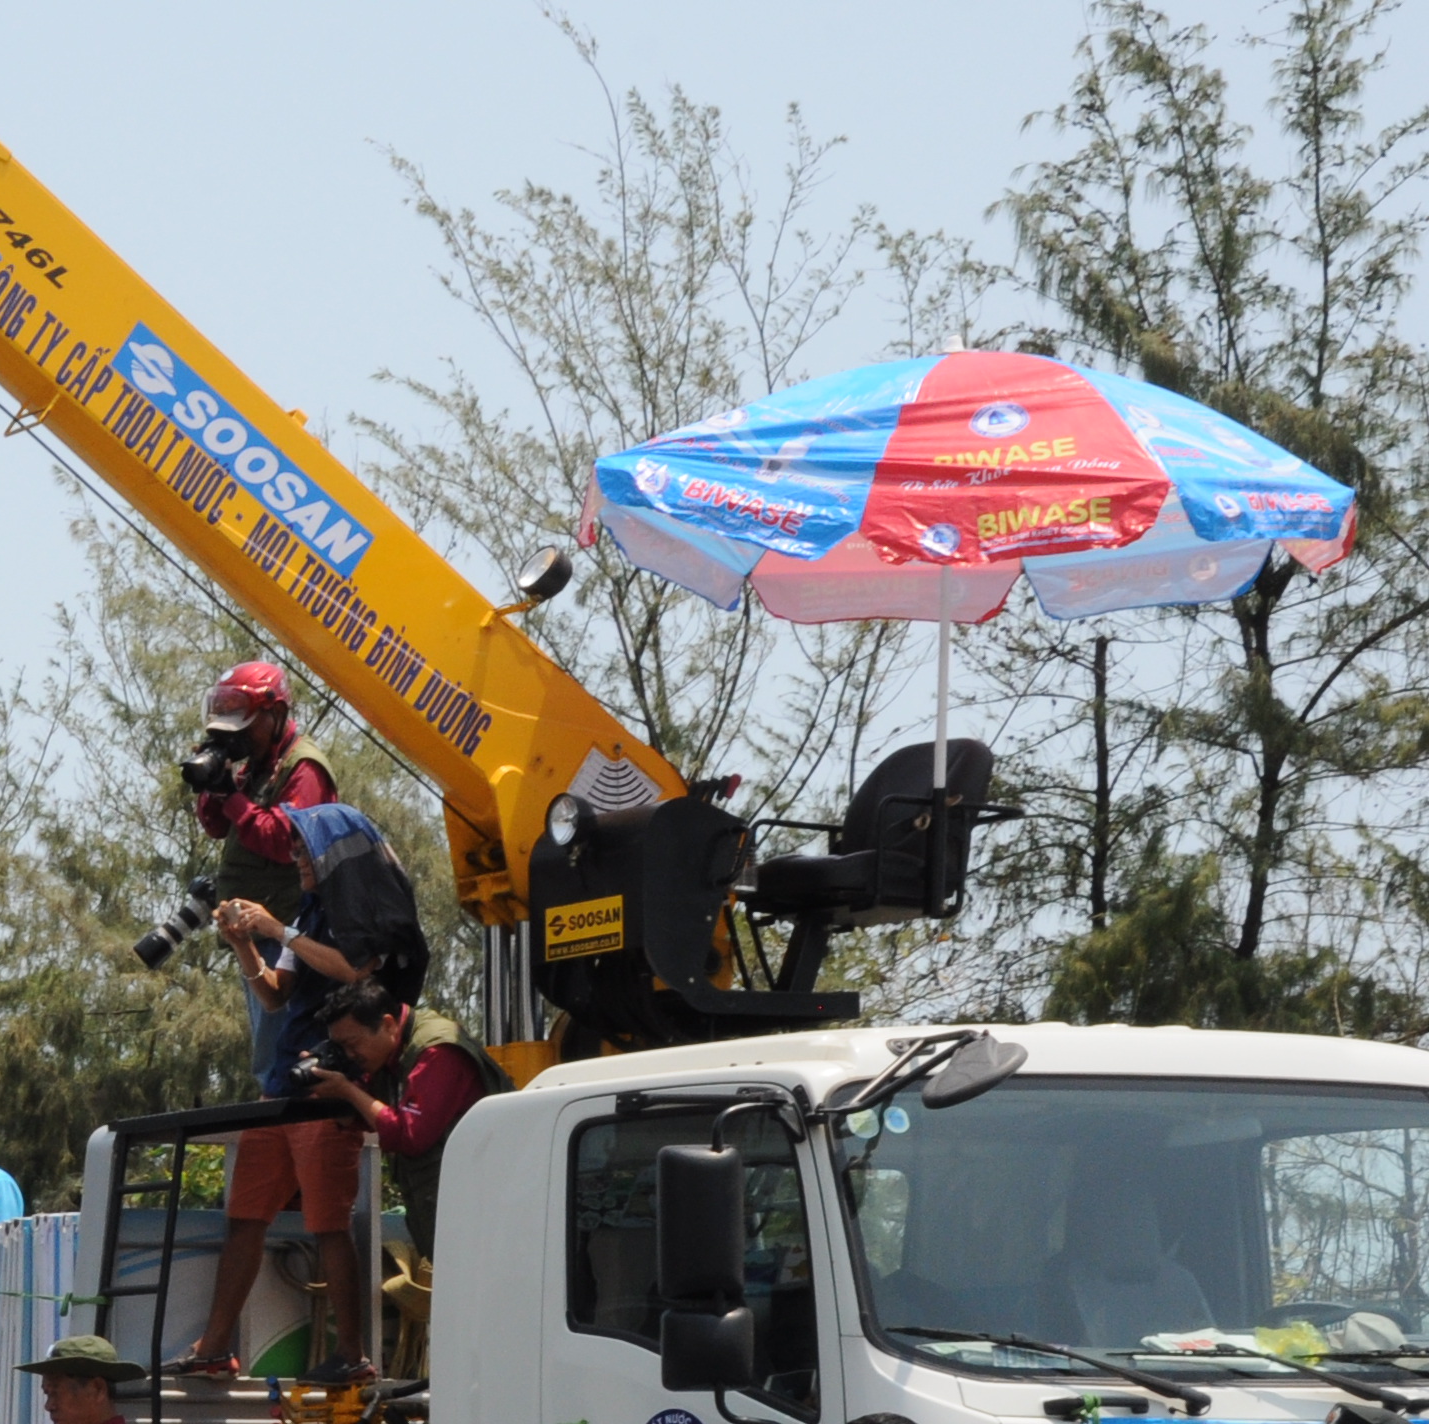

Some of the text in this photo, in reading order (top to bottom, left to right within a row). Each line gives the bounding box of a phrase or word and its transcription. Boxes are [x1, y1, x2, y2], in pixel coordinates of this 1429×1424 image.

[174, 390, 368, 565] SOOSAN
[25, 310, 71, 368] TY
[55, 341, 115, 407] CẤP
[102, 376, 184, 478] THOÁT
[166, 428, 240, 528] NƯỚC
[241, 512, 301, 587] MÔI
[292, 554, 378, 655] TRƯỜNG
[364, 626, 428, 697] BÌNH
[414, 669, 493, 758] DƯƠNG
[682, 478, 809, 537] BIWASE
[977, 498, 1112, 540] BIWASE
[569, 907, 620, 931] SOOSAN
